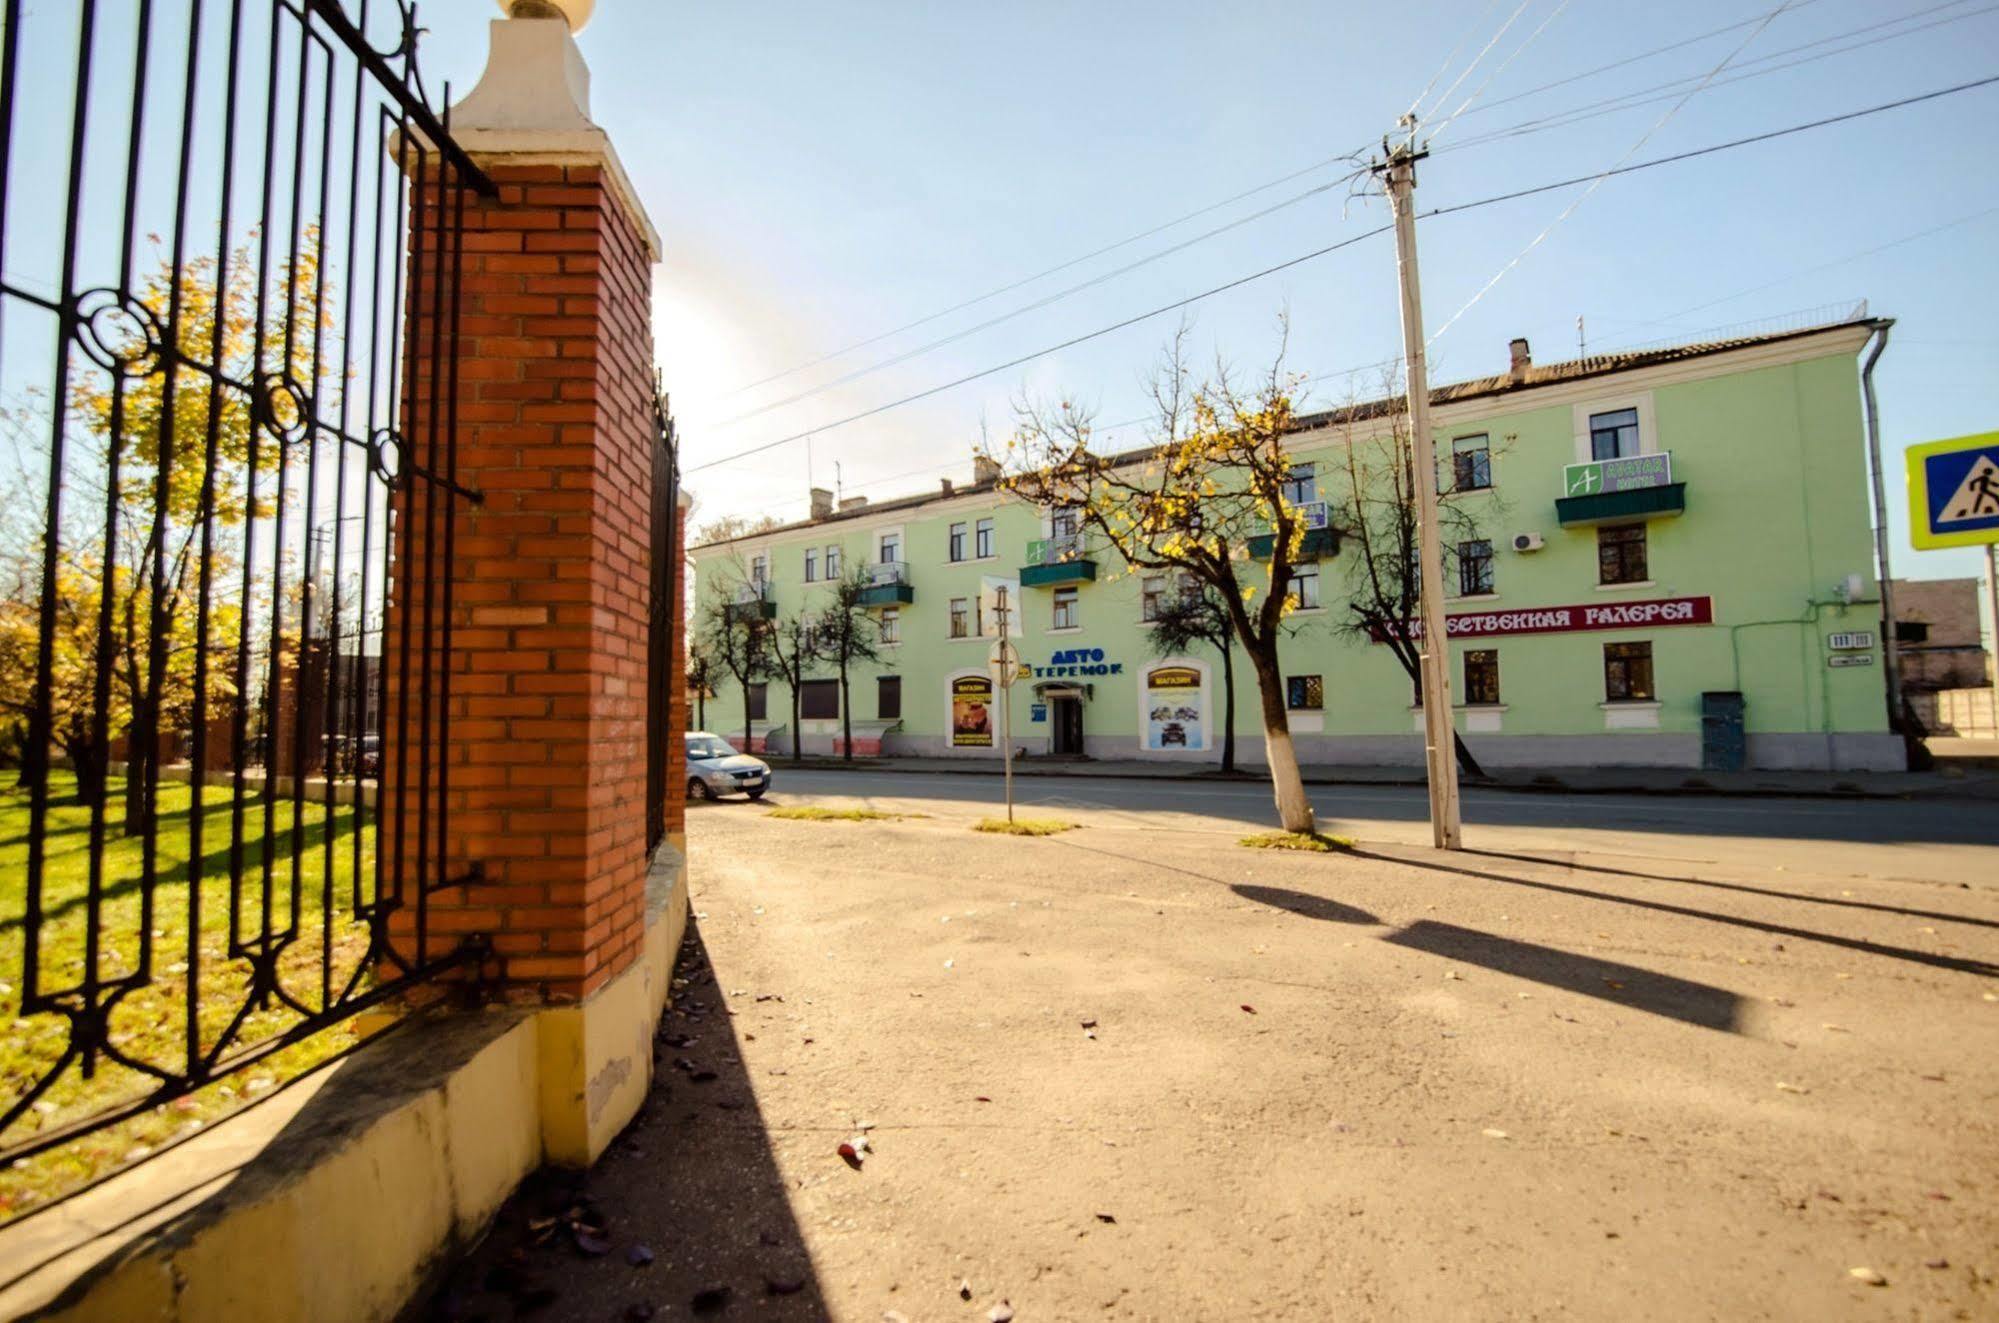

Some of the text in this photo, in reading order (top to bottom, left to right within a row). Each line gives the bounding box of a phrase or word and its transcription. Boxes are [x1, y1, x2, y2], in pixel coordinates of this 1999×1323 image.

[1607, 459, 1665, 477] AVATAR
[1384, 602, 1693, 637] ХОЕСТВЕННАЯ ГАЛЕРЕЯ
[1051, 648, 1105, 665] АВТО
[1034, 664, 1123, 678] ТЕРЕМОК
